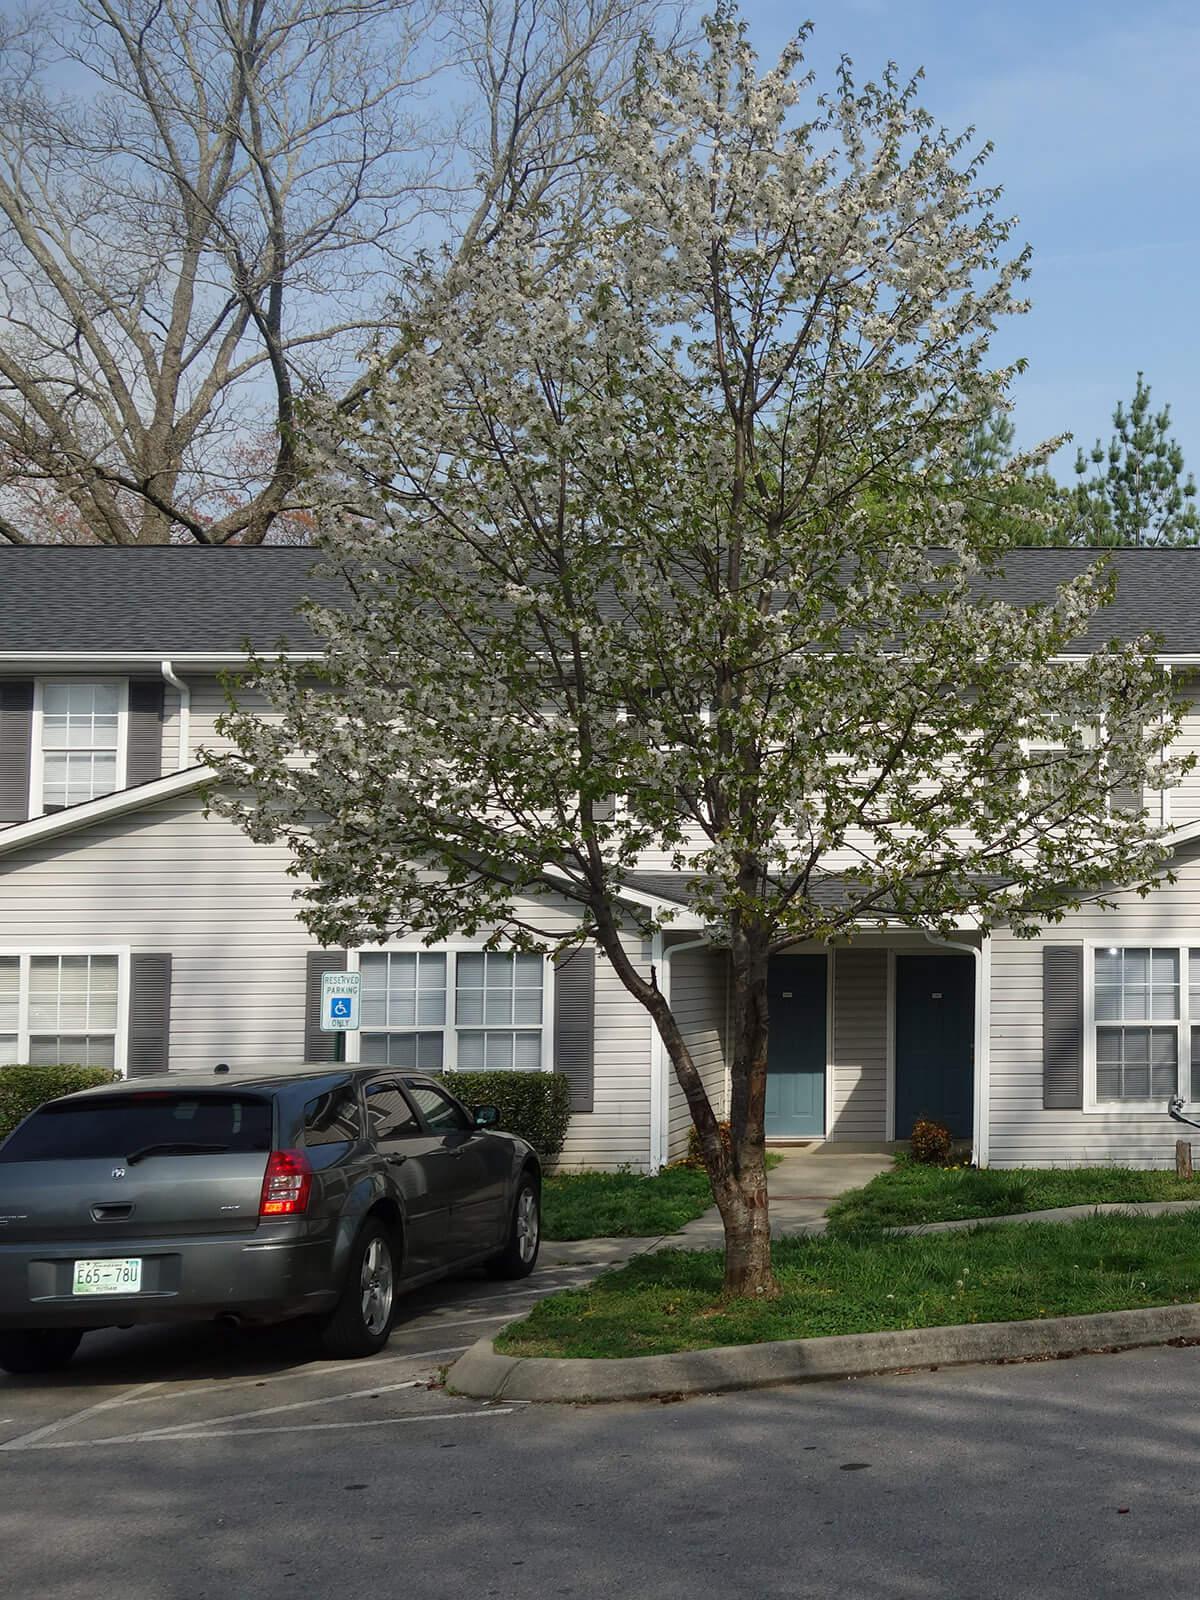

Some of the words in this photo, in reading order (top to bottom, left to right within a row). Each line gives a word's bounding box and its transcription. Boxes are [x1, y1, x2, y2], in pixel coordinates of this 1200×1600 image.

[324, 976, 360, 985] RESERVED
[327, 986, 358, 994] PARKING
[331, 1019, 350, 1027] ONLY
